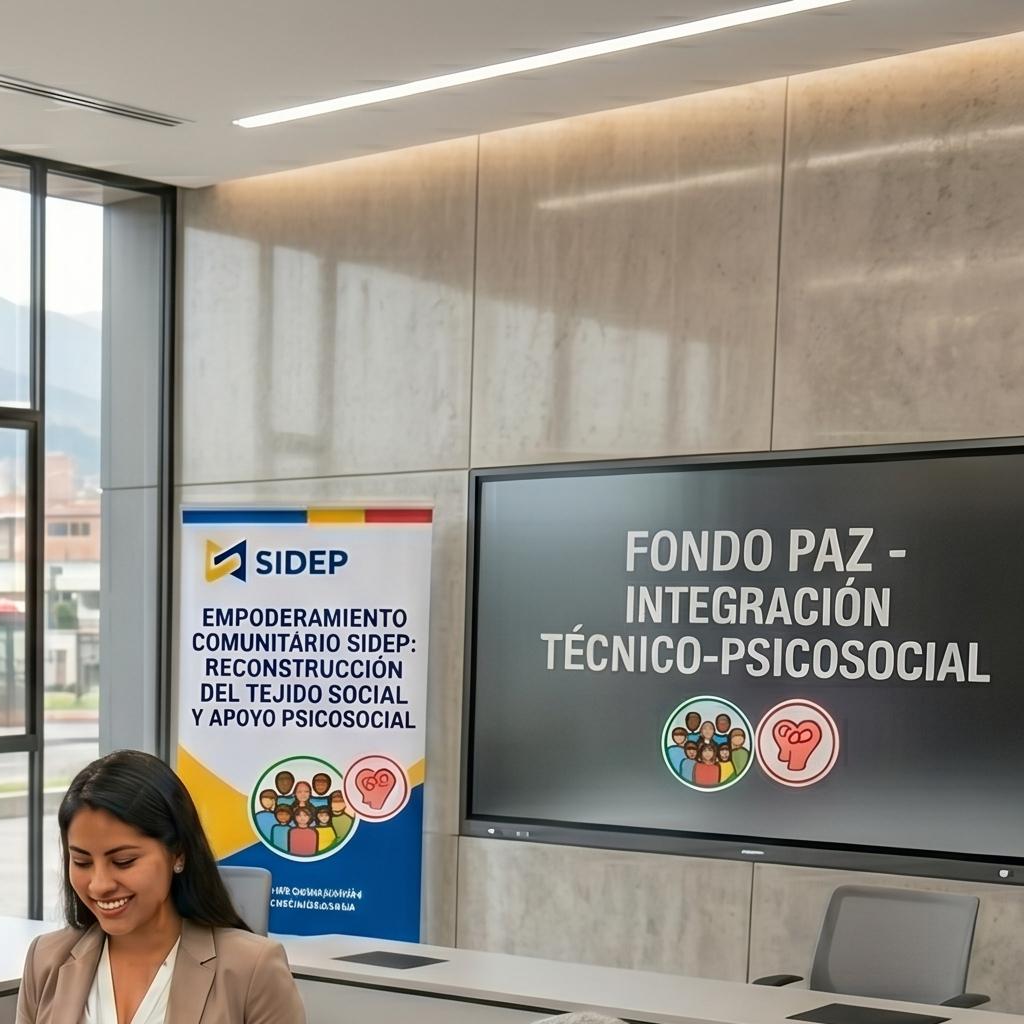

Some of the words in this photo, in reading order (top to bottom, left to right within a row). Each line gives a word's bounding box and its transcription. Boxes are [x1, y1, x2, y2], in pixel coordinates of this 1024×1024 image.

[625, 529, 773, 573] FONDO
[788, 526, 875, 573] PAZ
[888, 549, 907, 558] -
[256, 550, 349, 575] SIDEP
[625, 577, 891, 627] INTEGRACIÓN
[202, 607, 408, 628] EMPODERAMIENTO
[192, 631, 341, 653] COMUNITÁRIO
[347, 633, 416, 653] SIDEP:
[540, 624, 991, 683] TÉCNICO-PSICOSOCIAL
[205, 655, 403, 679] RECONSTRUCCIÓN
[200, 683, 240, 703] DEL
[245, 684, 323, 704] TEJIDO
[328, 684, 409, 705] SOCIAL
[191, 708, 204, 727] Y
[208, 709, 276, 728] APOYO
[281, 709, 416, 729] PSICOSOCIAL
